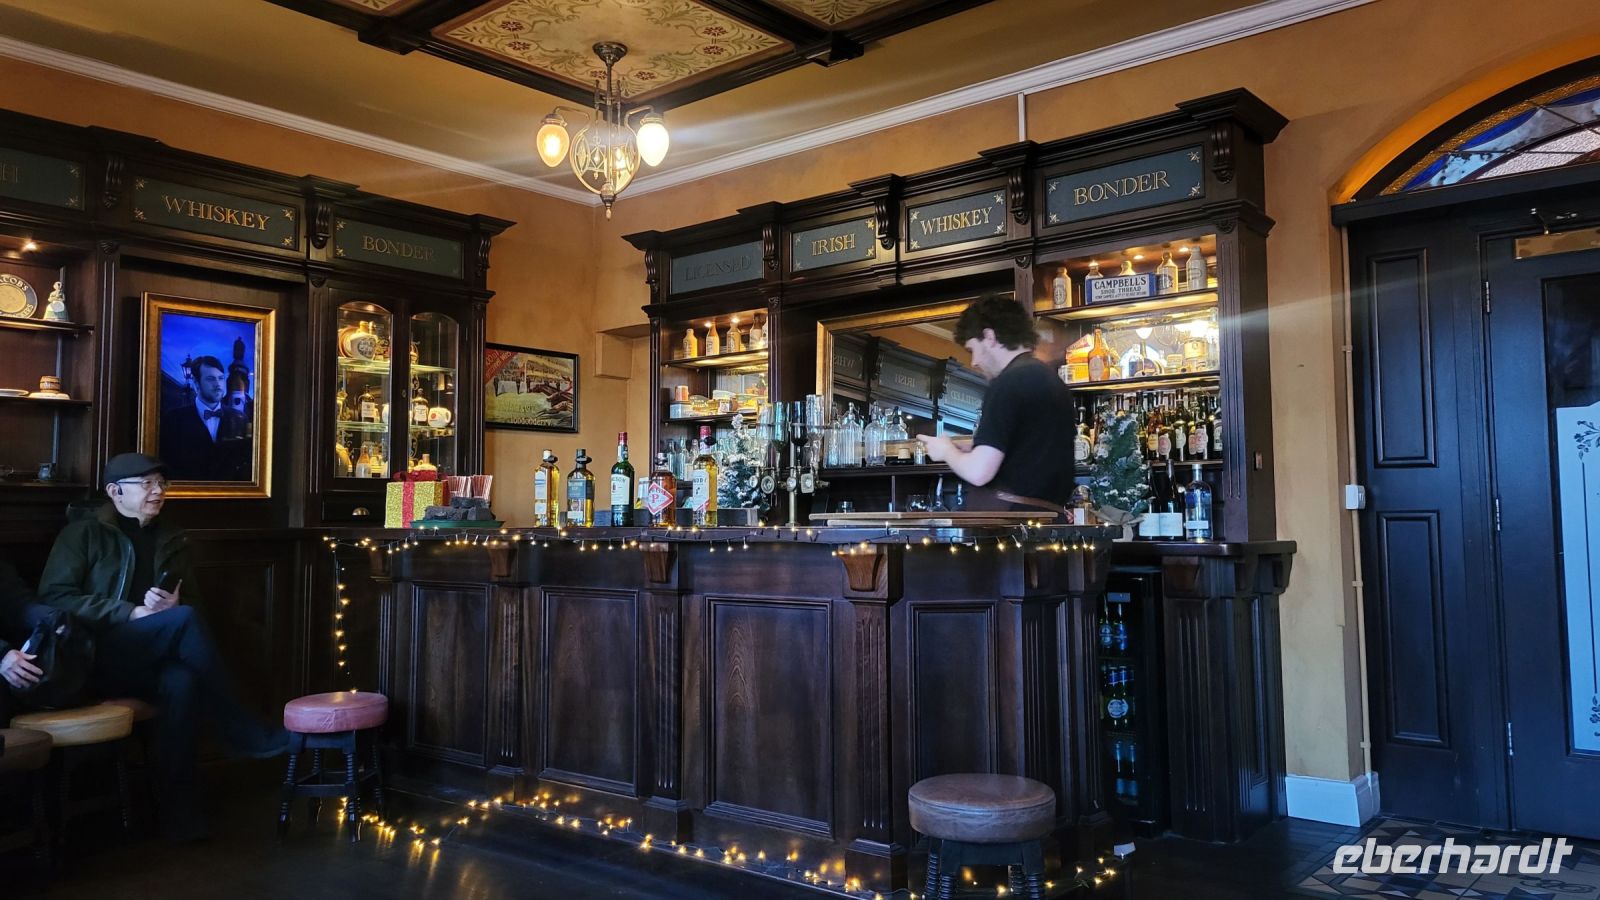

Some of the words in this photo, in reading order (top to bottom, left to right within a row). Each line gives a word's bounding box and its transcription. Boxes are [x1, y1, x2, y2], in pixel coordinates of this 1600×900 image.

[162, 194, 271, 231] WHISKEY
[361, 234, 436, 263] BONDER
[685, 256, 751, 281] LICENSED
[811, 233, 856, 257] IRISH
[920, 206, 993, 236] WHISKEY
[1073, 170, 1171, 206] BONDER
[1094, 276, 1147, 290] CAMPBELL'S
